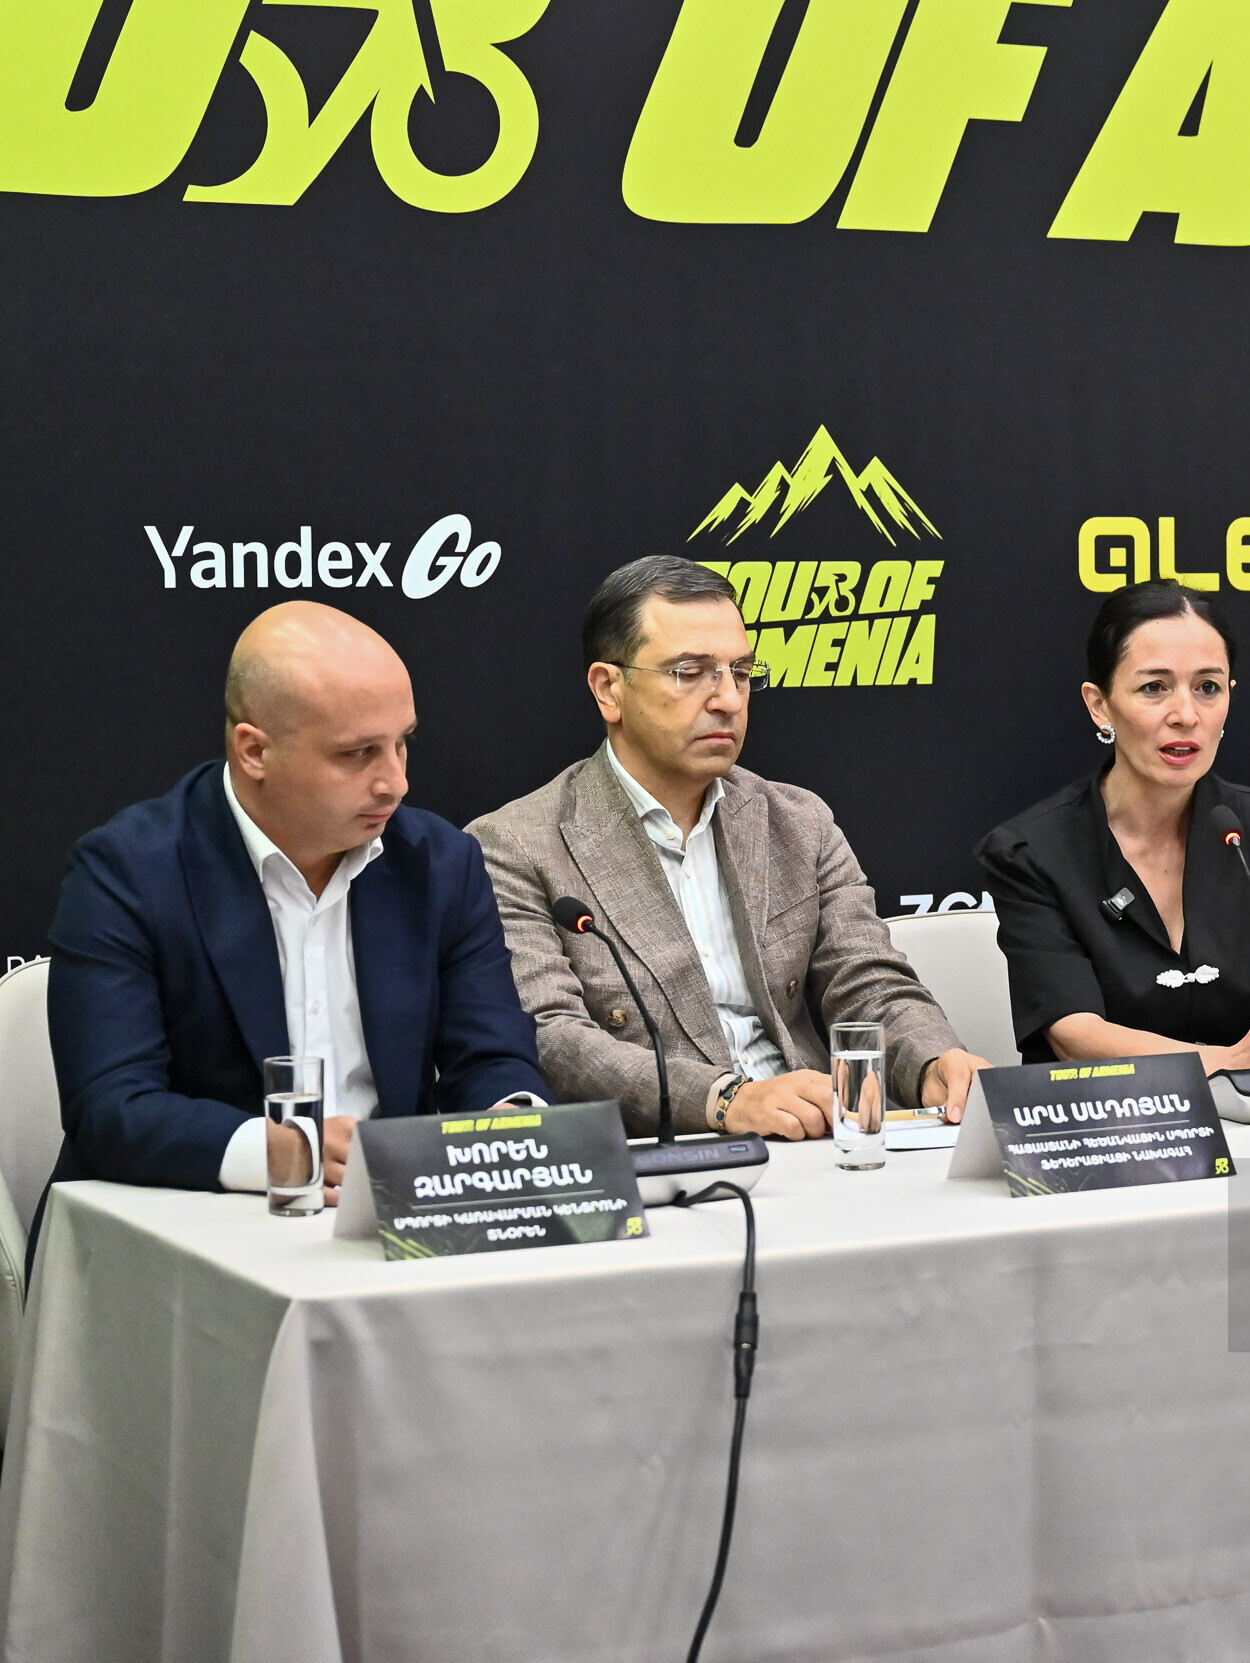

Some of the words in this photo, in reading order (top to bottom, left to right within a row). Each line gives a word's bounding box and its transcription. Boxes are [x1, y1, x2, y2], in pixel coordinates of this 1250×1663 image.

[622, 0, 1072, 233] OF
[144, 525, 394, 589] Yandex
[400, 513, 502, 600] Go
[697, 560, 862, 625] OUR
[858, 560, 945, 615] OF
[746, 614, 936, 688] MENIA
[1013, 1103, 1069, 1127] ԱՐԱ
[1071, 1094, 1191, 1122] ՍԱԴՈՅԱՆ
[413, 1162, 593, 1199] ԶԱՐԳԱՐՅԱՆ
[446, 1138, 549, 1167] ԽՈՐԵՆ
